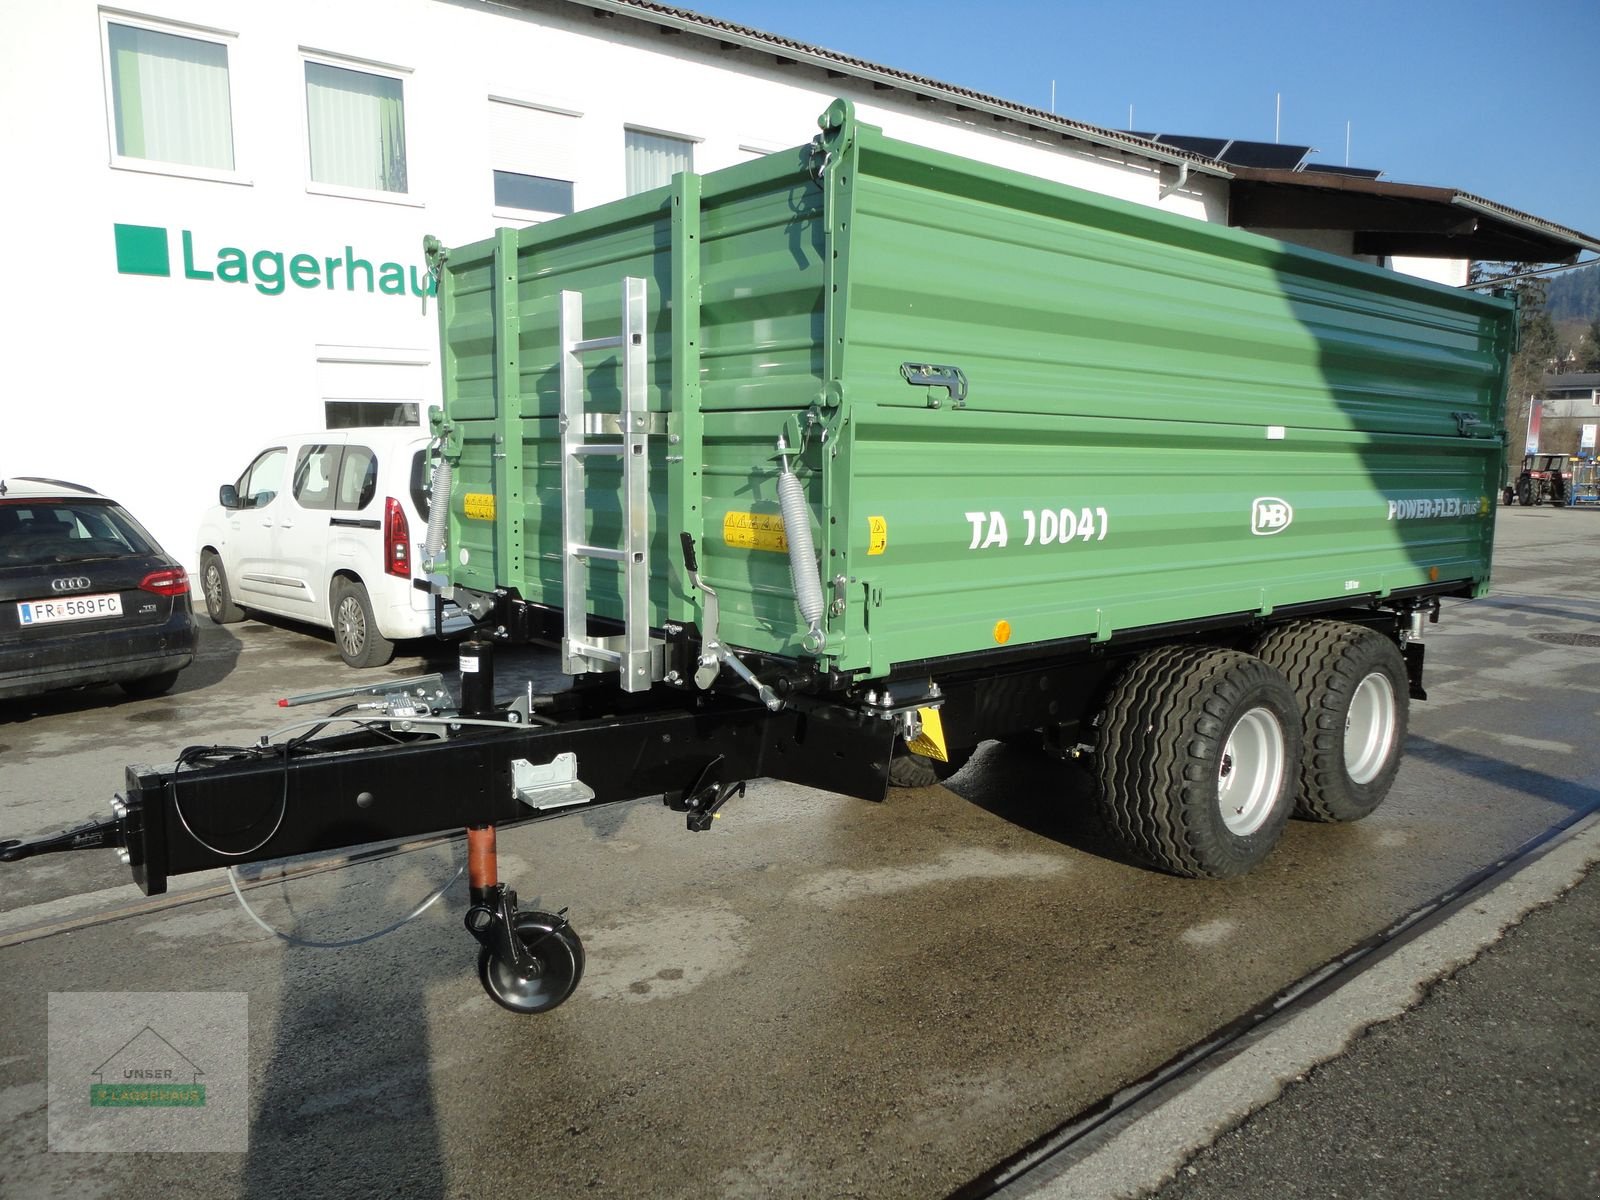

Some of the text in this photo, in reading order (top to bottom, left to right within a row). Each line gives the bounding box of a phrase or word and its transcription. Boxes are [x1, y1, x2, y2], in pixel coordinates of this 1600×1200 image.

[182, 229, 437, 298] Lagerhau
[1387, 497, 1461, 521] POWER-FLEX
[964, 506, 1108, 550] TA 10041
[35, 604, 55, 619] FR
